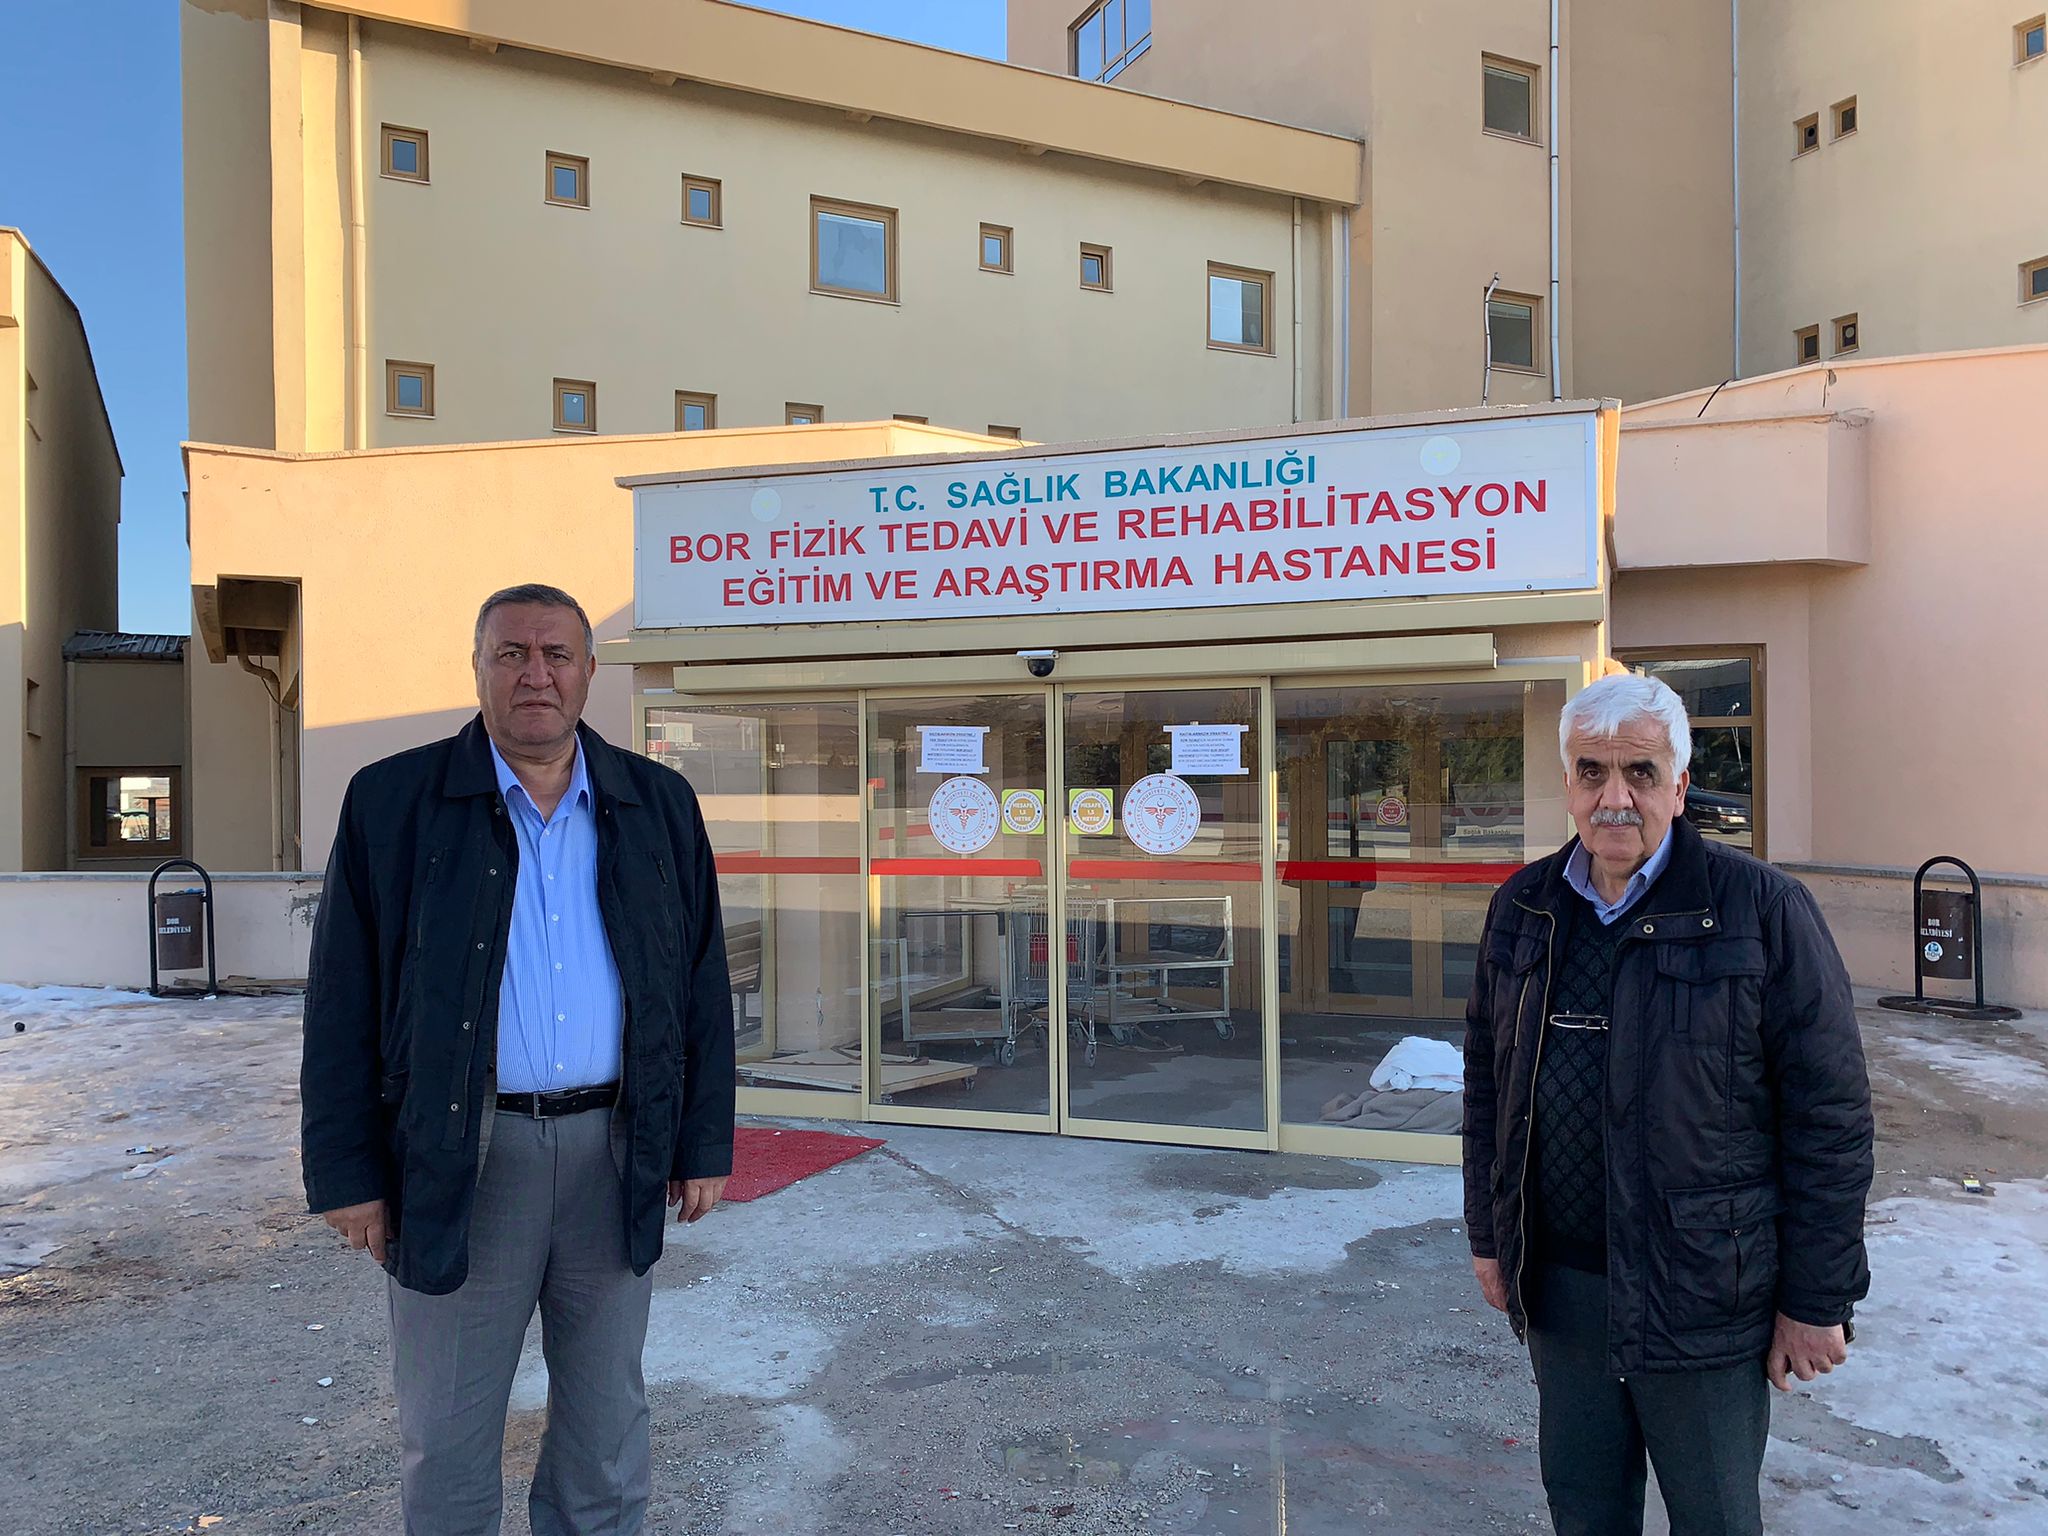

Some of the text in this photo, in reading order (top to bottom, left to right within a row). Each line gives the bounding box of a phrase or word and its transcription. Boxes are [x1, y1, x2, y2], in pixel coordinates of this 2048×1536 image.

[868, 449, 1316, 513] T.C. SAĞLIK BAKANLIĞI
[669, 479, 1547, 564] BOR FİZİK TEDAVİ VE REHABİLİTASYON
[722, 527, 1496, 607] EĞİTİM VE ARAŞTIRMA HASTANESİ
